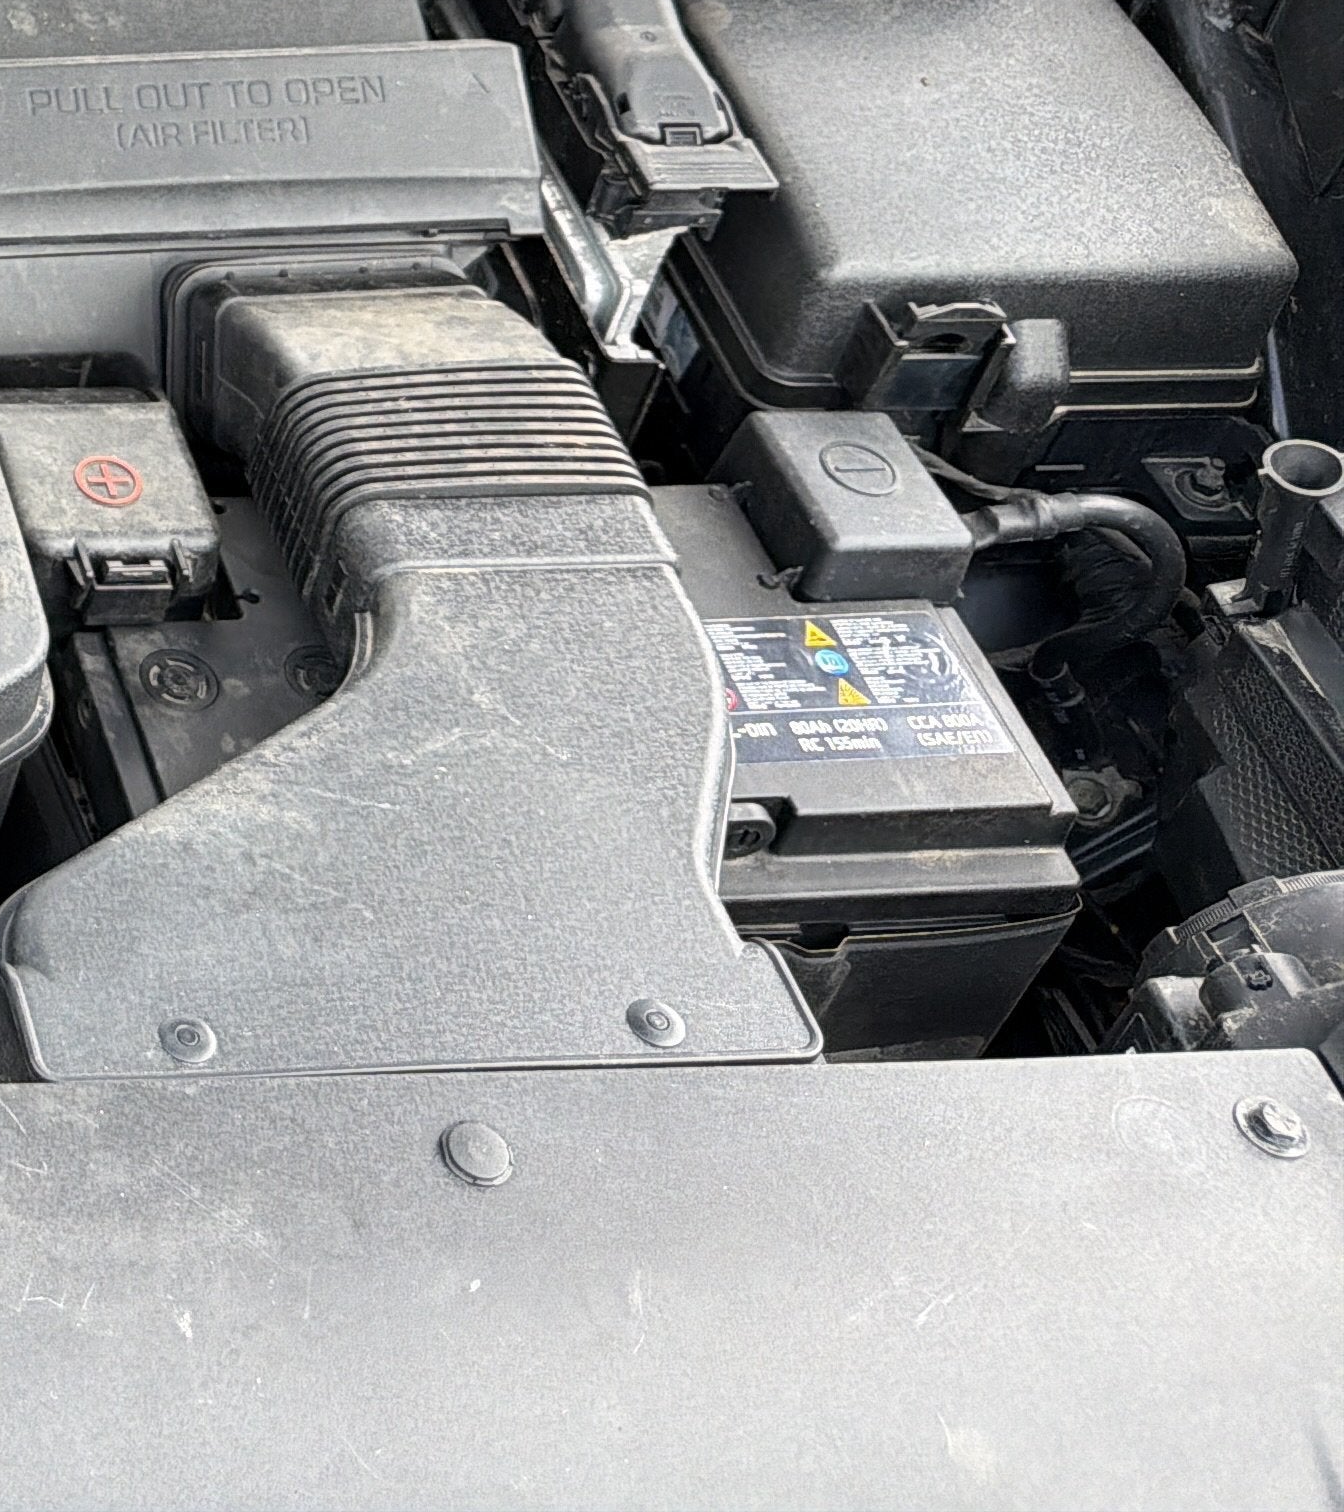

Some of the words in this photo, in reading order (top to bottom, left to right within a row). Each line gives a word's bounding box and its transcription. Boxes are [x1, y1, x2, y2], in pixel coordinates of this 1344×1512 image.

[27, 84, 123, 116] PULL
[136, 81, 210, 111] OUT
[218, 79, 272, 108] TO
[284, 75, 387, 105] OPEN
[907, 715, 943, 730] CCA
[798, 737, 825, 752] RC
